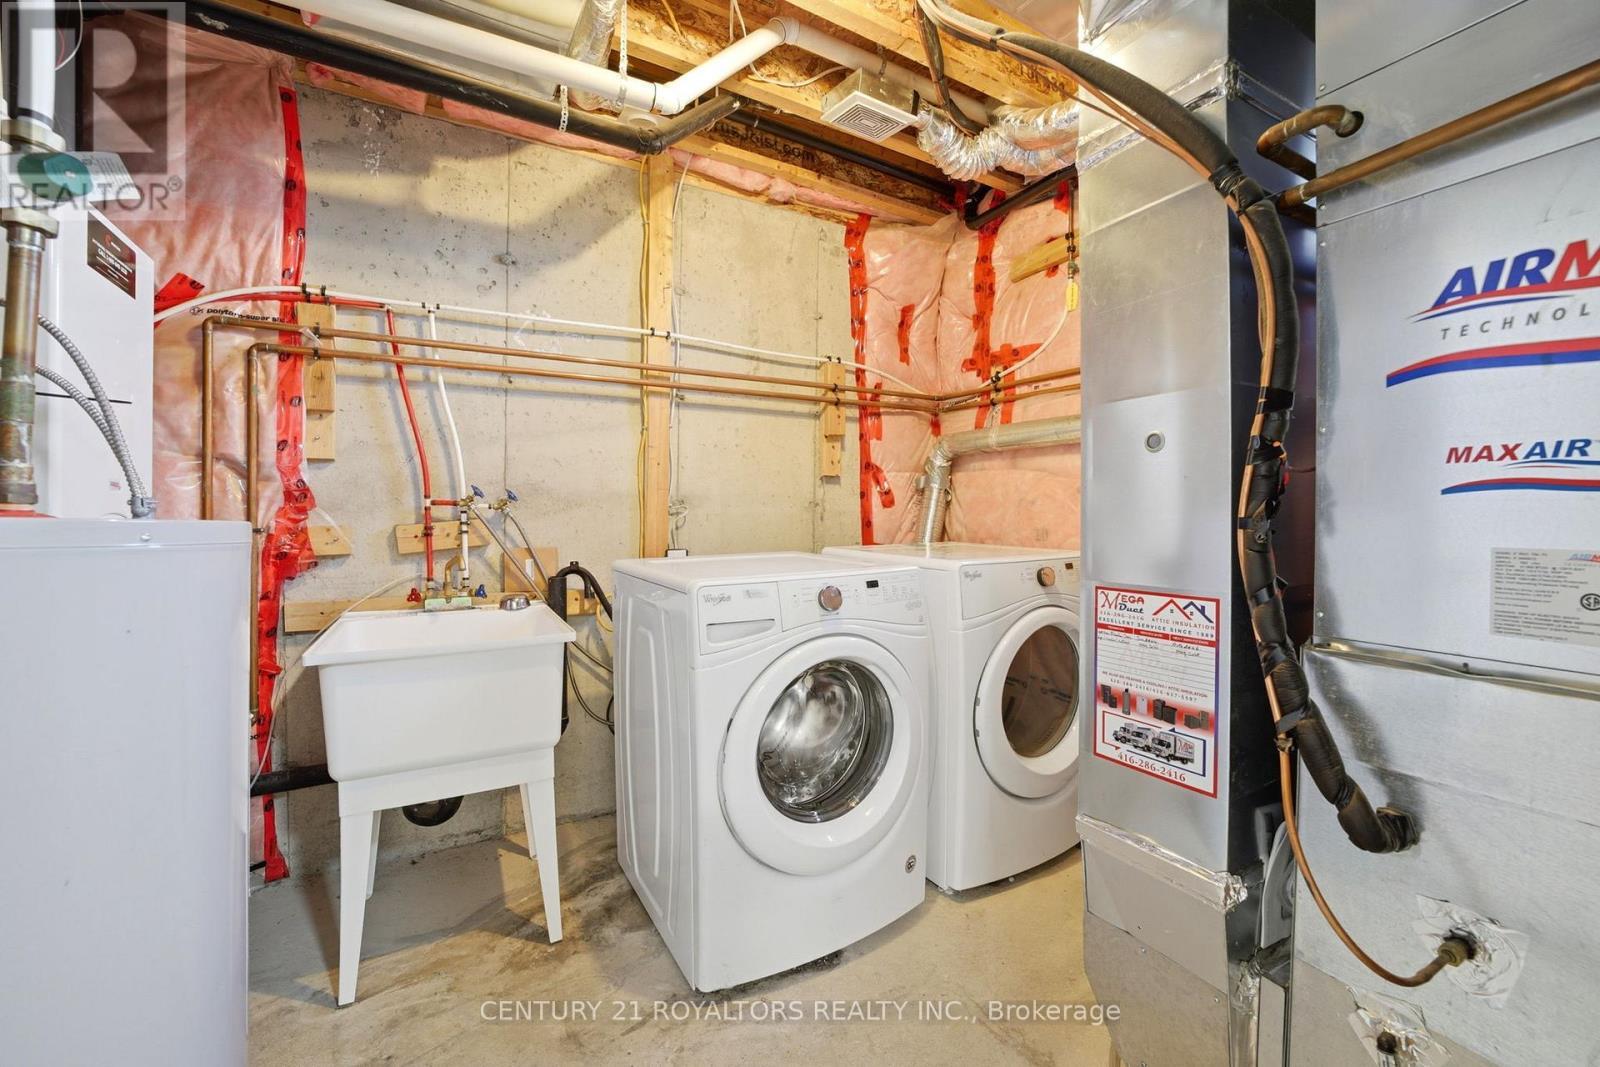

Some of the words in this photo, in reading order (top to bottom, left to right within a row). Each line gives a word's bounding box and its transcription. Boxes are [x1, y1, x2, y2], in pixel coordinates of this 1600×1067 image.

[1440, 303, 1591, 341] TECHNOL
[1446, 438, 1592, 464] MAXAIR
[1099, 590, 1145, 610] MEGA
[1119, 602, 1145, 614] Duct
[1098, 616, 1134, 627] EXCELLENT
[1137, 622, 1166, 632] SERVICE
[1170, 627, 1193, 635] SINCE
[1172, 620, 1215, 630] INSULATION
[1118, 753, 1186, 782] 416-286-2416
